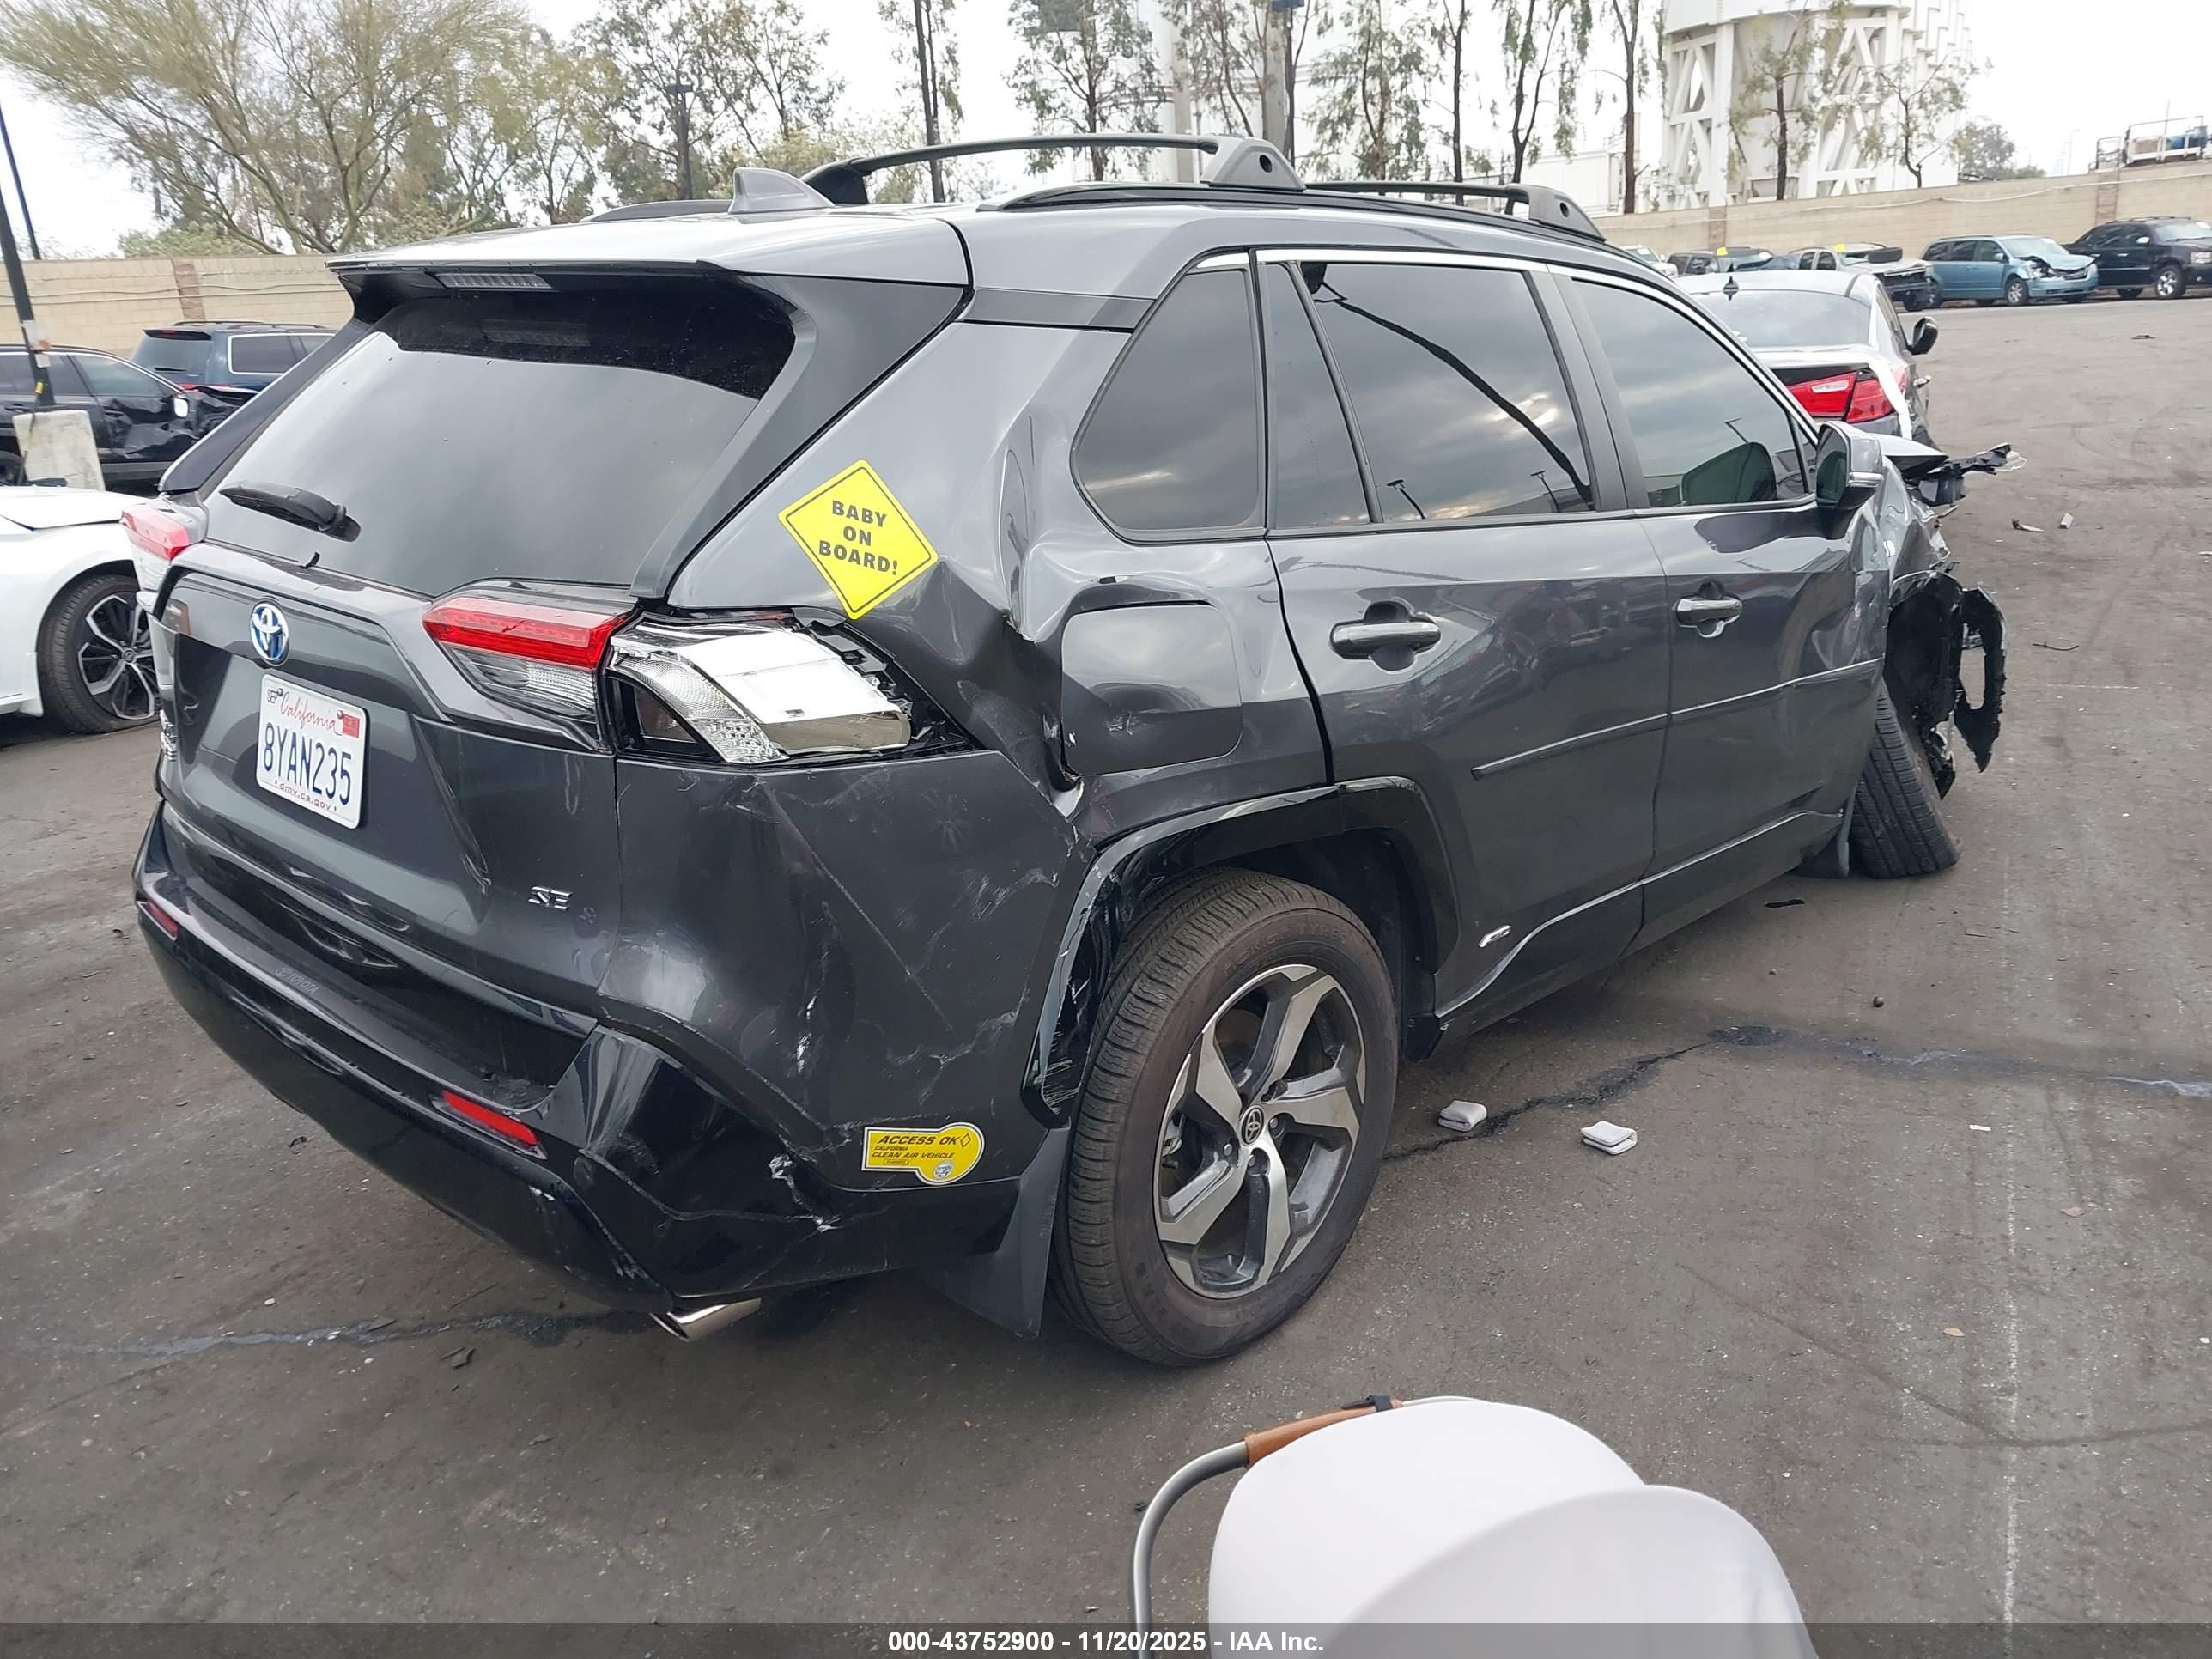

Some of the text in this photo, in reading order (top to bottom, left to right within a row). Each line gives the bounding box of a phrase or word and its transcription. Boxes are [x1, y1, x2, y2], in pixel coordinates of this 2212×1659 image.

[832, 500, 887, 527] BABY
[842, 526, 872, 546] ON
[818, 540, 898, 575] BOARD!
[281, 691, 343, 736] California
[263, 722, 352, 805] 8YAN235
[528, 886, 573, 910] SE
[878, 1135, 960, 1146] ACCESS OK
